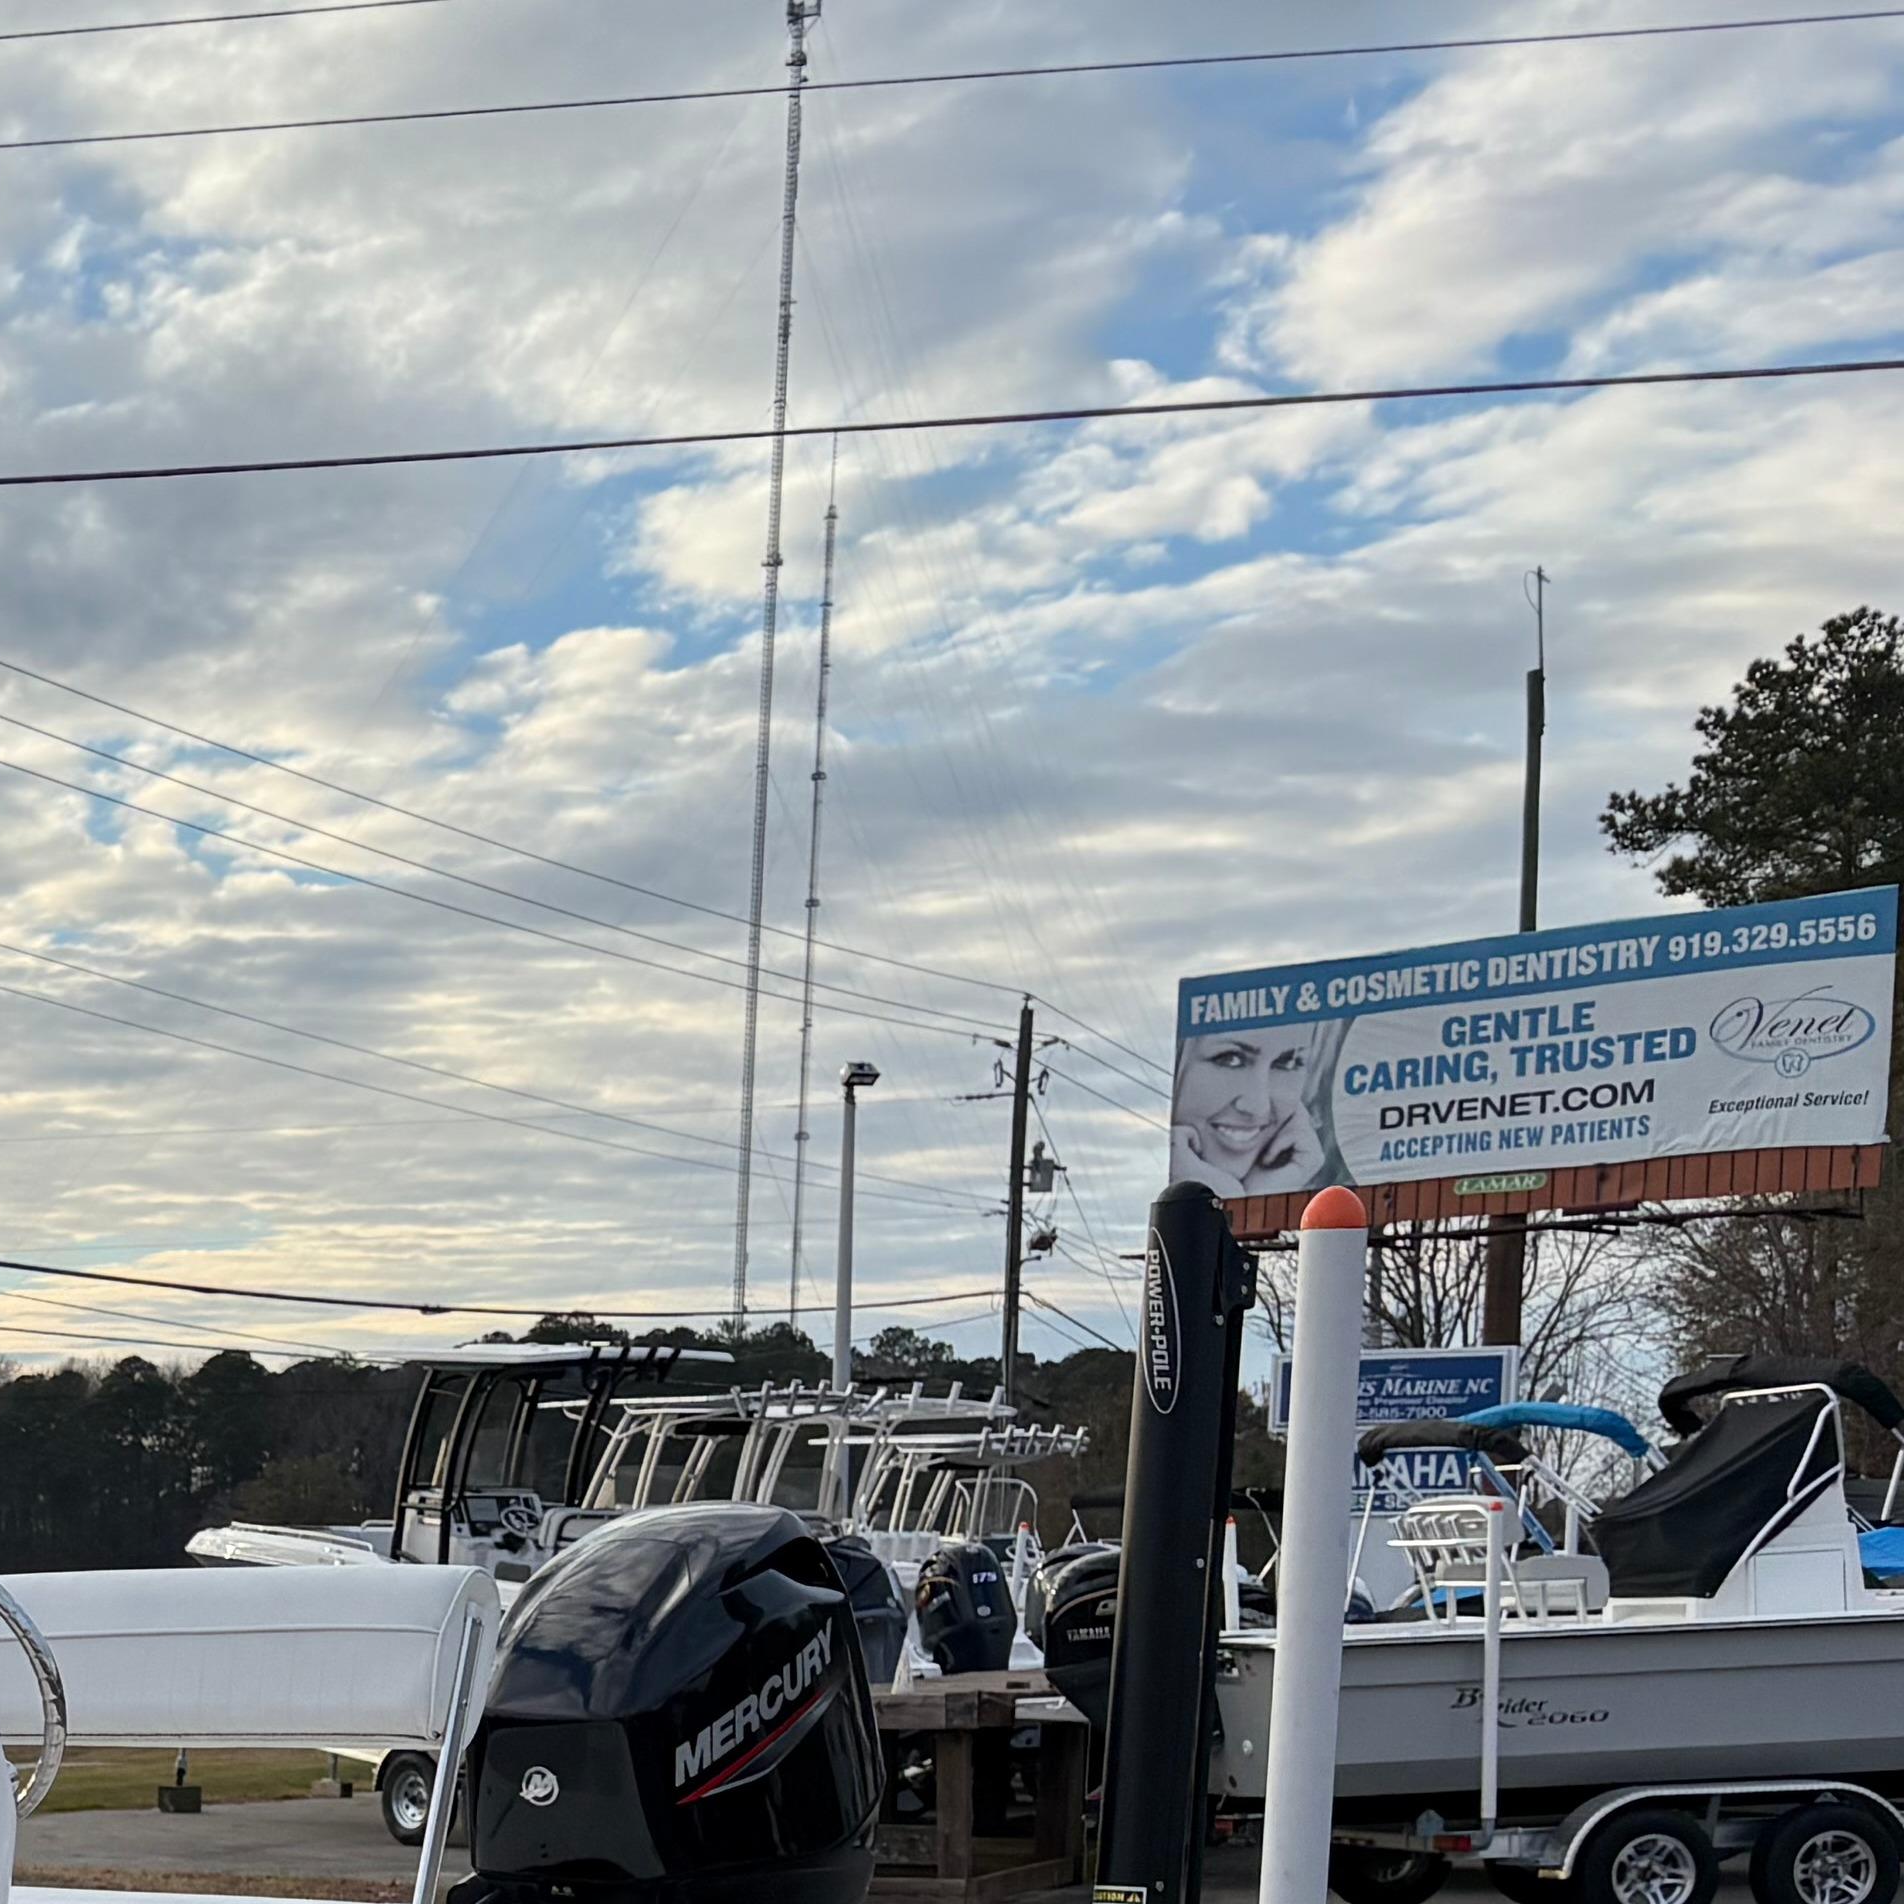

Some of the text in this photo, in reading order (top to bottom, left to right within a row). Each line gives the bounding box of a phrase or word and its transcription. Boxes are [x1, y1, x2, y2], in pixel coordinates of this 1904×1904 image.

[1190, 913, 1877, 1025] FAMILY & COSMETIC DENTISTRY 919.329.5556
[1442, 1001, 1595, 1047] GENTLE
[1344, 1027, 1696, 1096] CARING, TRUSTED
[1379, 1078, 1655, 1131] DRVENET.COM
[1708, 1090, 1869, 1115] Exceptional Service!
[1379, 1115, 1651, 1163] ACCEPTING NEW PATIENTS
[1148, 1250, 1171, 1390] POWER-POLE
[1381, 1377, 1461, 1396] MARINE
[1464, 1377, 1494, 1394] NC
[675, 1617, 833, 1787] MERCURY
